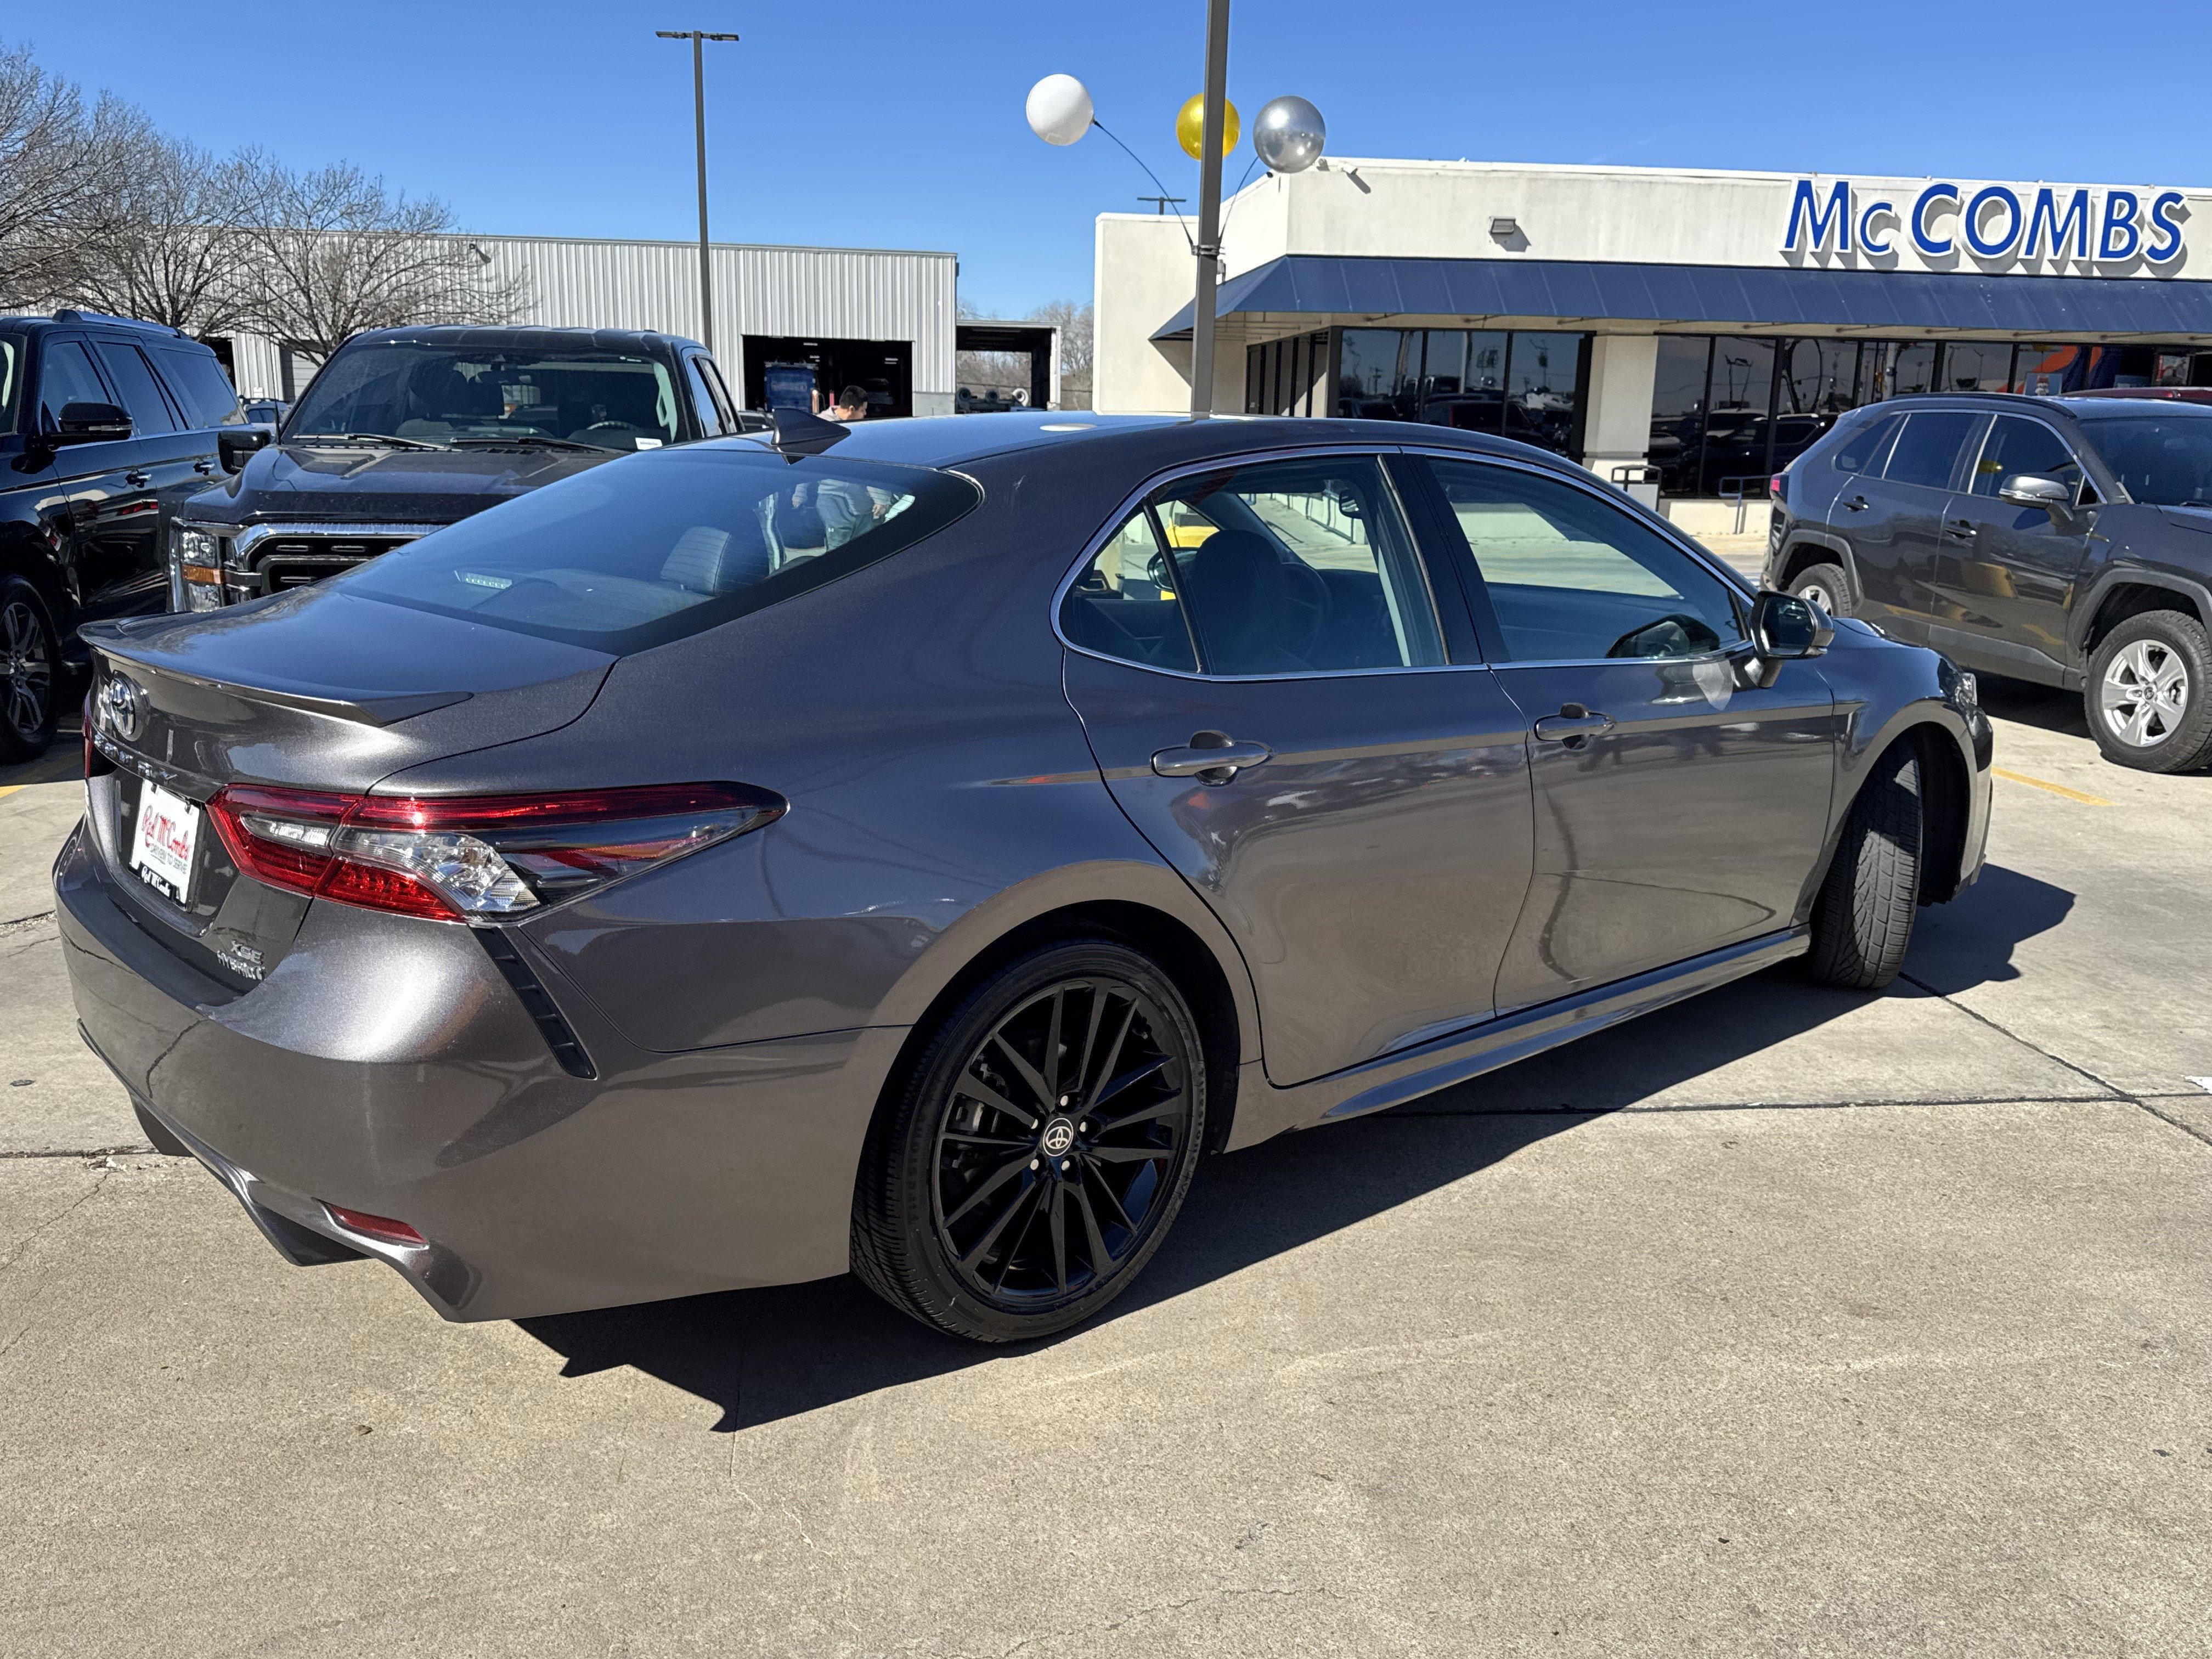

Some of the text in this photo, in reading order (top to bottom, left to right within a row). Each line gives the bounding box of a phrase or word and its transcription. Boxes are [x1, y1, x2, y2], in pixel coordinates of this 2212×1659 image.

[141, 804, 160, 848] Red
[167, 853, 173, 865] TO
[230, 940, 262, 965] XSE
